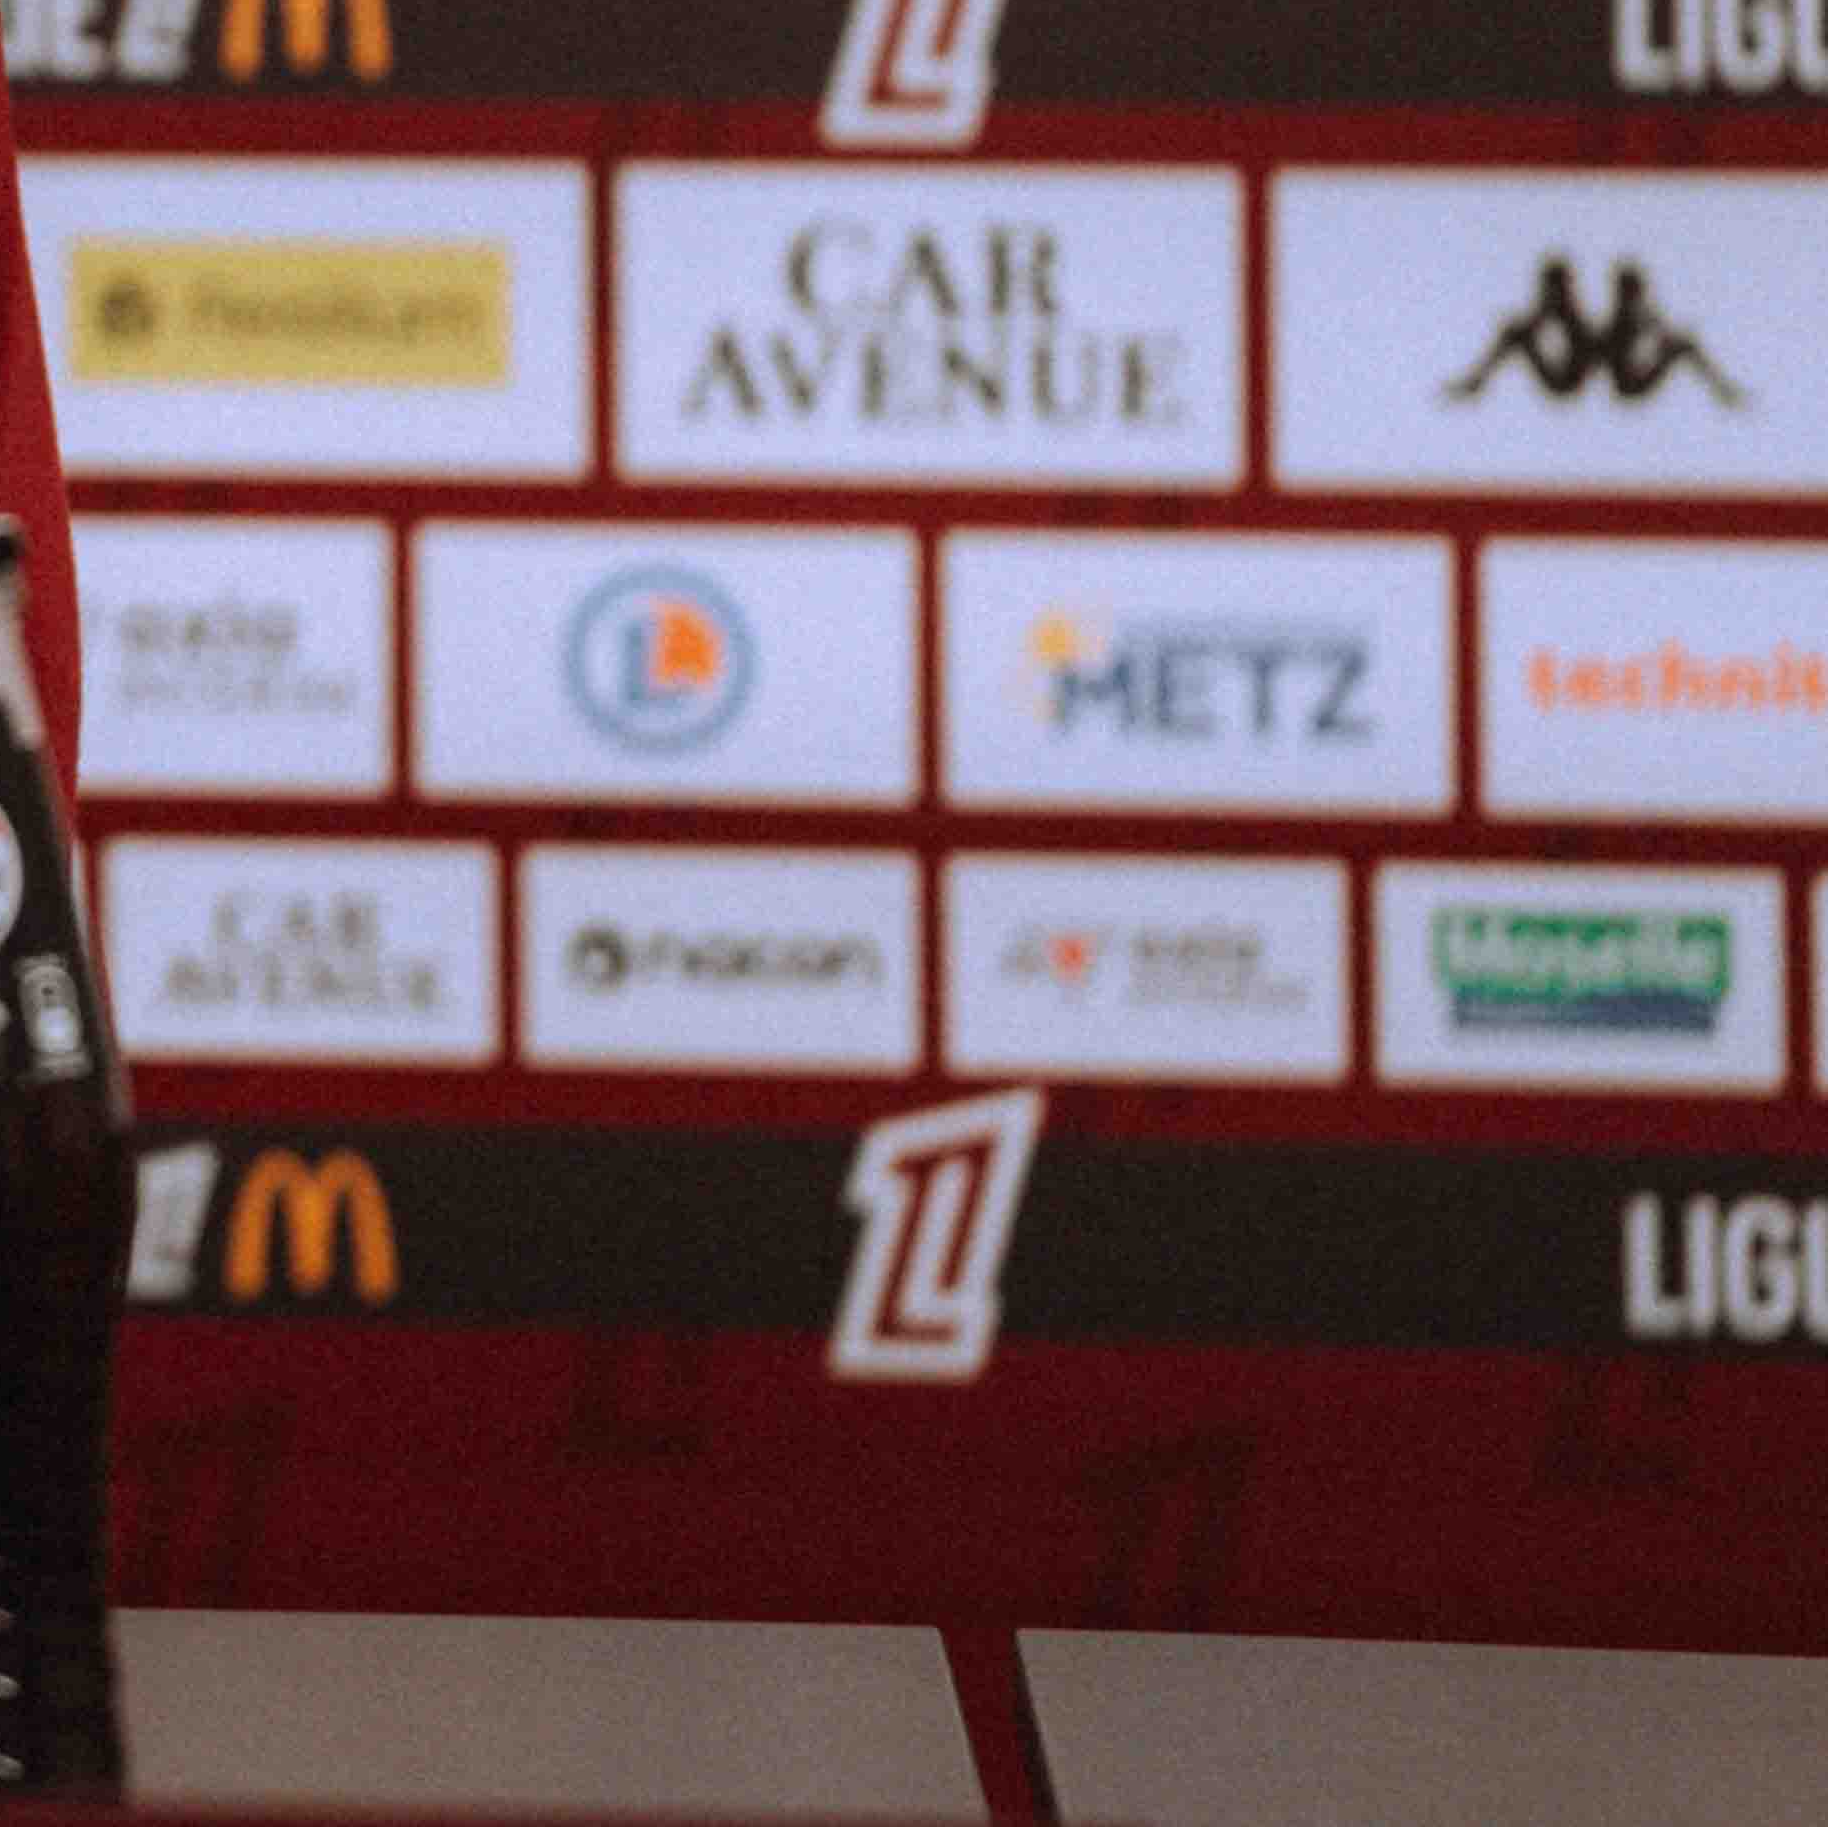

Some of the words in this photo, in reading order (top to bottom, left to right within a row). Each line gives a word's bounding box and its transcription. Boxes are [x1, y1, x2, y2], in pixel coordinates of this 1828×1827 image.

[786, 217, 1059, 319] CAR
[681, 322, 1187, 426] AVENUE
[1052, 640, 1373, 741] METZ
[1621, 1191, 1828, 1340] LIG
